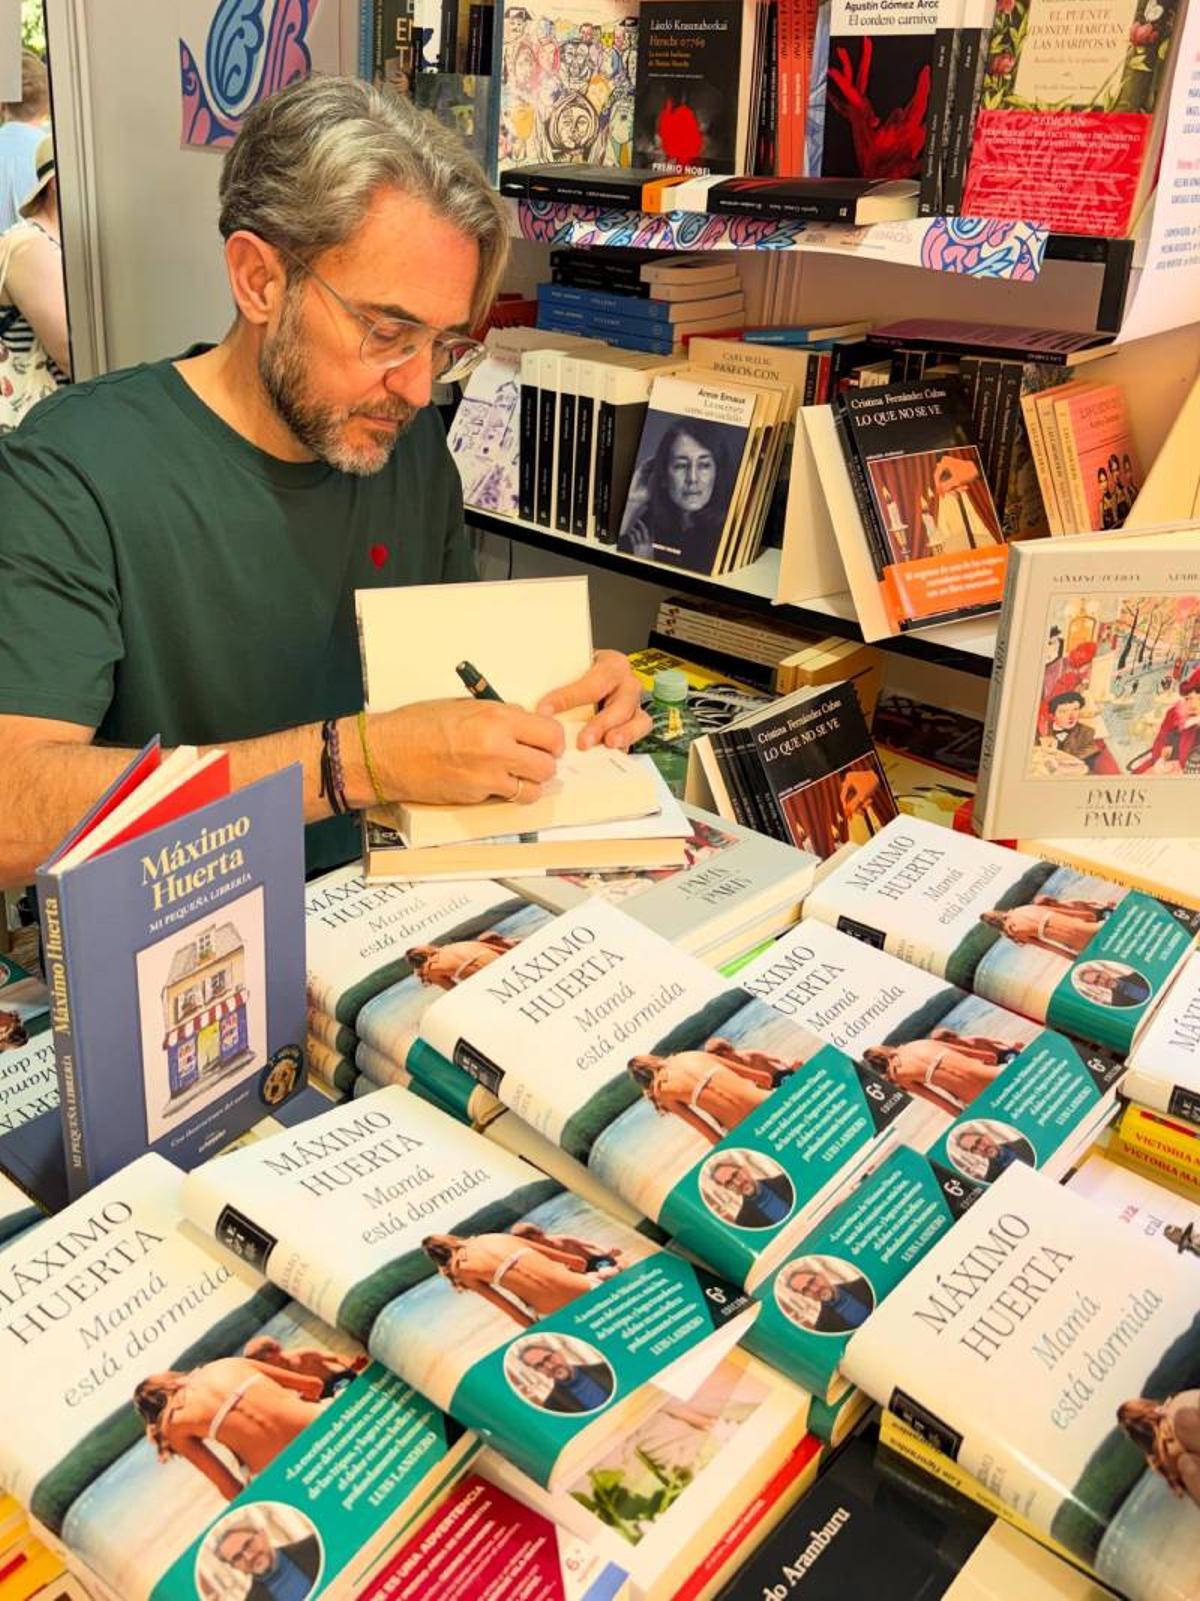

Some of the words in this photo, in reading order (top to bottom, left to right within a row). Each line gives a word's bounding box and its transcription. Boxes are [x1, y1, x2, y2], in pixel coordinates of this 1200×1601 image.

[861, 14, 896, 26] cordero
[851, 397, 884, 409] Cristina
[856, 415, 871, 427] LO
[872, 410, 898, 427] QUE
[898, 407, 914, 421] NO
[915, 405, 928, 418] SE
[927, 403, 943, 415] VE
[758, 727, 787, 745] Cristina
[763, 746, 779, 763] LO
[779, 736, 802, 757] QUE
[801, 728, 817, 746] NO
[816, 723, 829, 740] SE
[827, 717, 840, 732] VE
[140, 815, 251, 887] Máximo
[152, 848, 245, 912] Huerta
[847, 835, 917, 890] MÁXIMO
[878, 847, 946, 901] HUERTA
[149, 920, 162, 934] MI
[162, 894, 210, 930] PEQUEÑA
[210, 872, 252, 902] LIBRERÍA
[368, 894, 429, 934] Mamá
[923, 866, 964, 902] Mamá
[957, 861, 1002, 912] dormida
[45, 897, 65, 961] Huerta
[359, 932, 396, 959] está
[398, 892, 472, 939] dormida
[486, 923, 597, 1005] MÁXIMO
[518, 946, 625, 1024] HUERTA
[742, 945, 816, 998] ÁXIMO
[771, 961, 846, 1017] UERTA
[51, 961, 71, 1035] Máximo
[574, 978, 637, 1034] Mamá
[575, 1034, 616, 1072] está
[614, 978, 686, 1046] dormida
[807, 985, 860, 1032] Mamá
[844, 982, 906, 1043] dormida
[262, 1110, 393, 1176] MÁXIMO
[299, 1132, 424, 1198] HUERTA
[361, 1214, 408, 1246] está
[407, 1166, 491, 1224] dormida
[362, 1163, 434, 1210] Mamá
[7, 1228, 164, 1346] HUERTA
[912, 1212, 1031, 1336] MÁXIMO
[959, 1245, 1075, 1363] HUERTA
[64, 1351, 121, 1408] está
[125, 1263, 234, 1360] dormida
[78, 1270, 169, 1350] Mamá
[1031, 1291, 1102, 1371] Mamá
[1050, 1372, 1096, 1431] está
[1087, 1286, 1164, 1384] dormida
[396, 1549, 423, 1579] UNA
[419, 1480, 485, 1555] ADVERTENCIA
[781, 1506, 851, 1587] Aramburu
